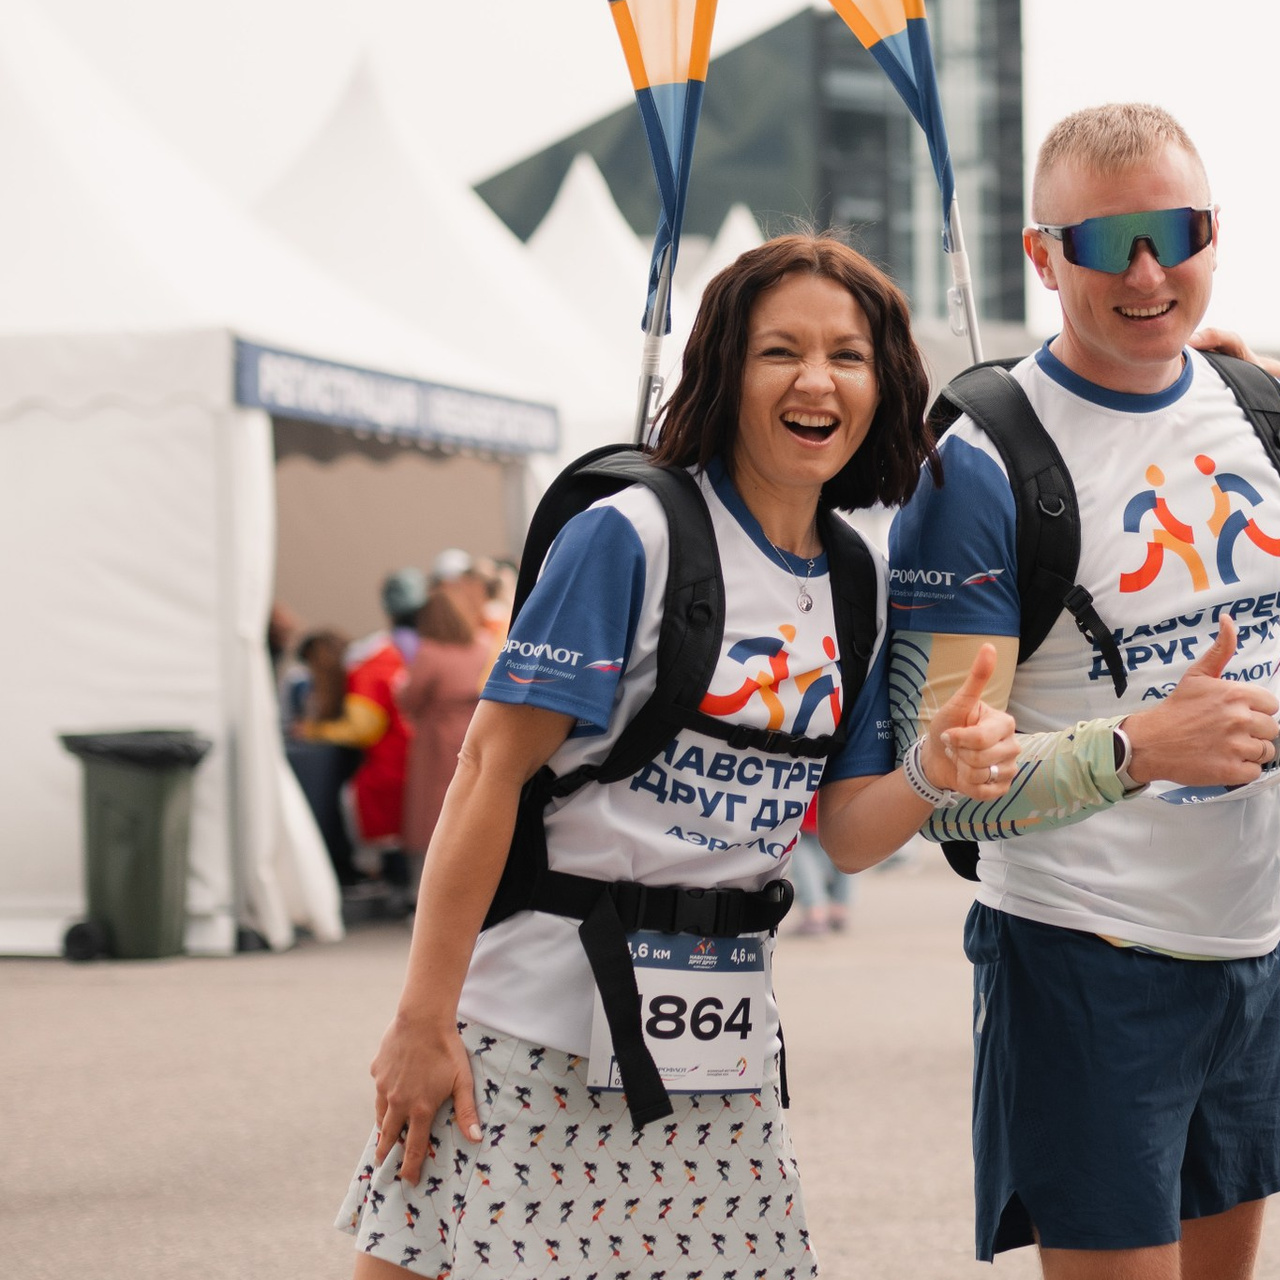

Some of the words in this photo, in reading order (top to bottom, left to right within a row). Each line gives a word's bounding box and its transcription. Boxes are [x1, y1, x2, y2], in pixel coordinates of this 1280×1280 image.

[629, 762, 747, 822] ДРУГ
[751, 799, 808, 832] ДР
[730, 948, 745, 964] 4,6
[638, 994, 752, 1041] 864
